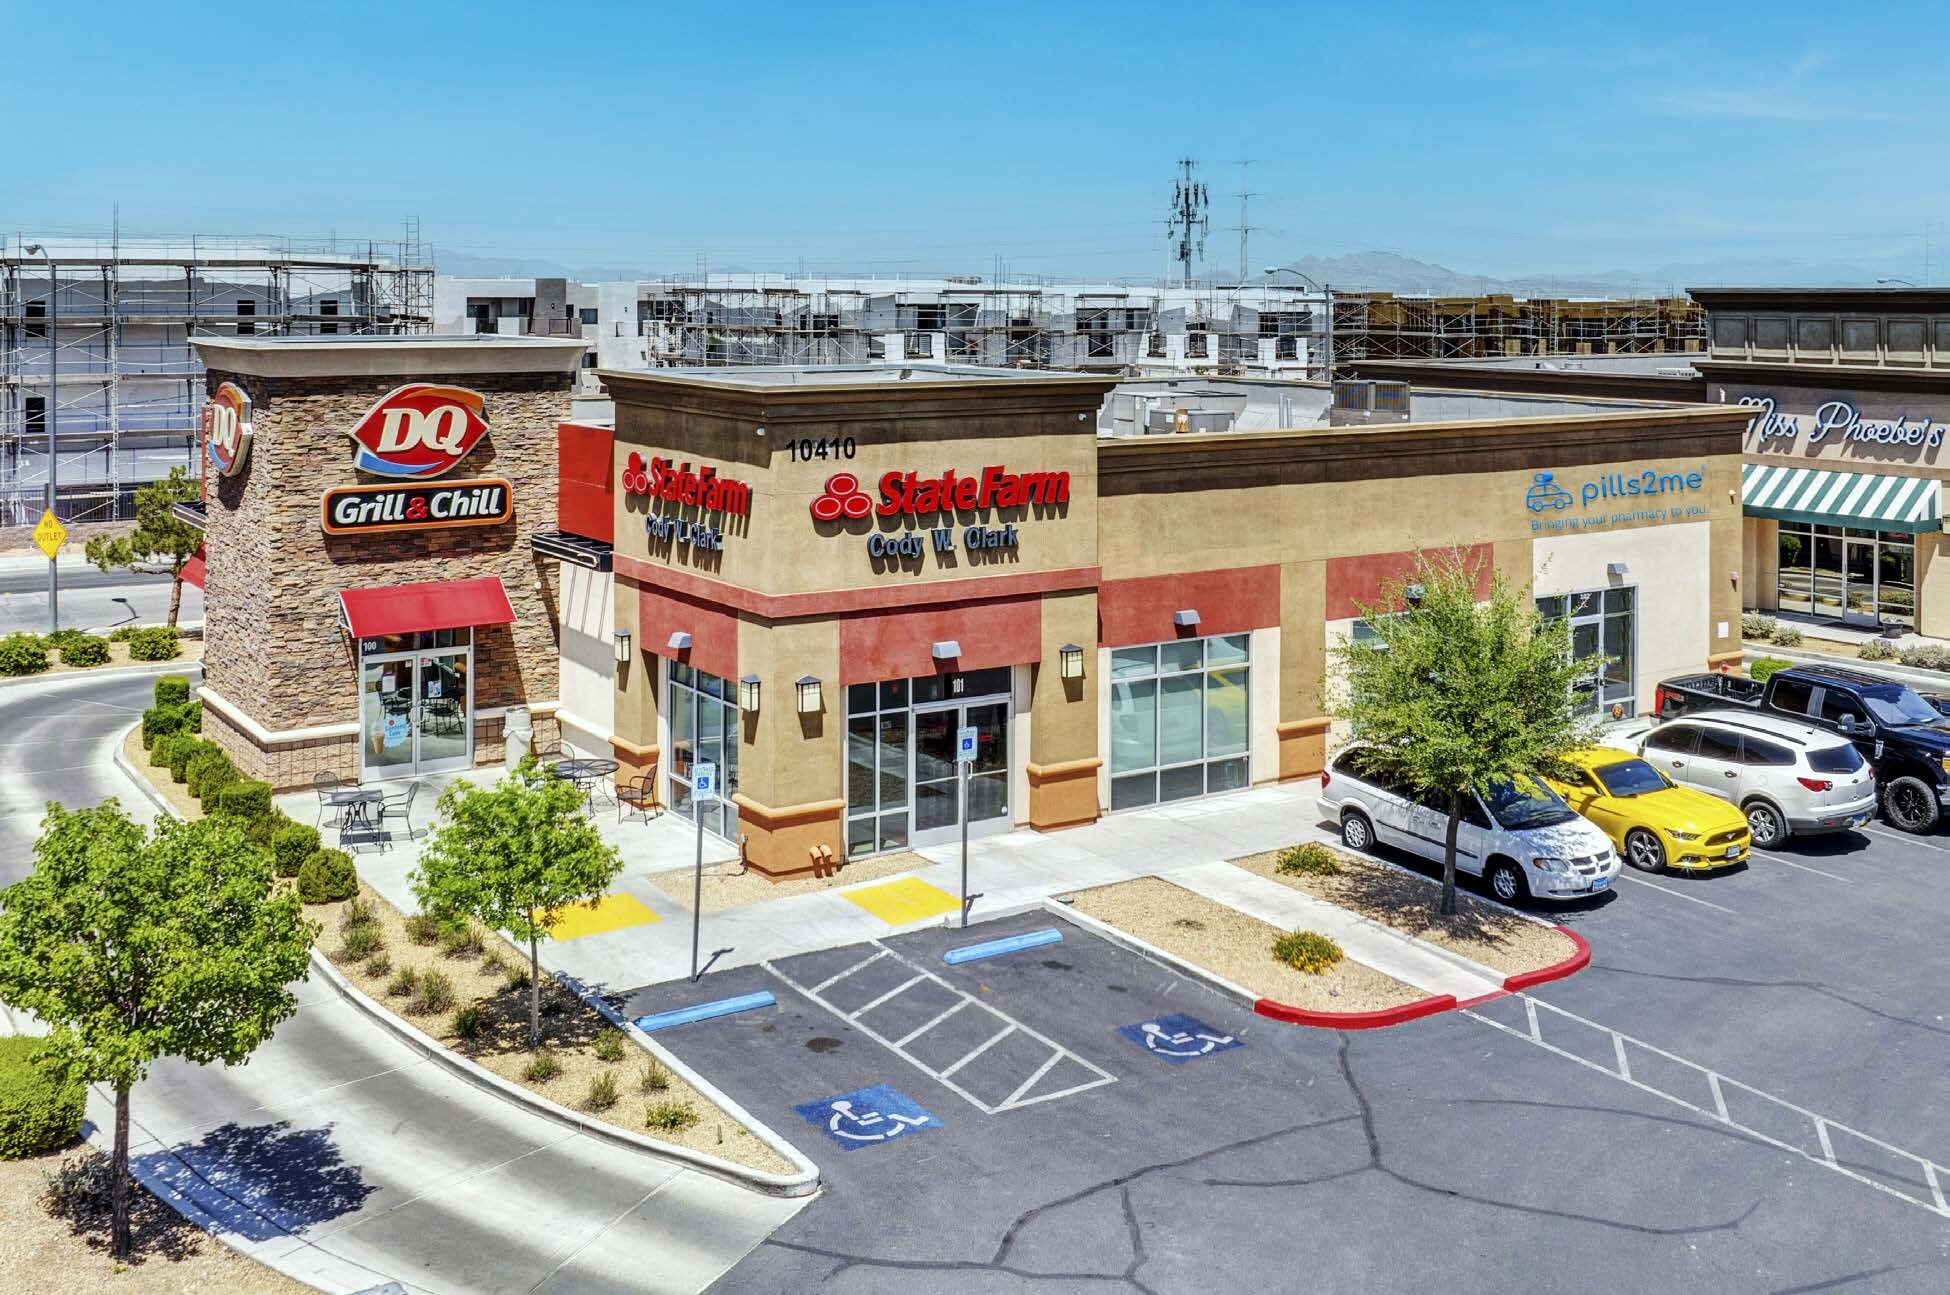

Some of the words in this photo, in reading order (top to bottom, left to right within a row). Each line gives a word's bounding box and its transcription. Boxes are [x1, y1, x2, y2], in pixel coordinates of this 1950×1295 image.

[212, 403, 238, 458] DQ
[376, 405, 469, 456] DQ
[1810, 401, 1946, 447] Phoebe's
[785, 436, 856, 462] 10410
[1531, 518, 1579, 531] Bringing
[1583, 514, 1607, 529] your
[1611, 509, 1667, 525] pharmacy
[1670, 506, 1683, 518] to
[691, 522, 723, 551] Clark
[867, 533, 924, 560] Cody
[964, 523, 1018, 550] Clark
[362, 641, 377, 652] 100
[953, 678, 964, 693] 101
